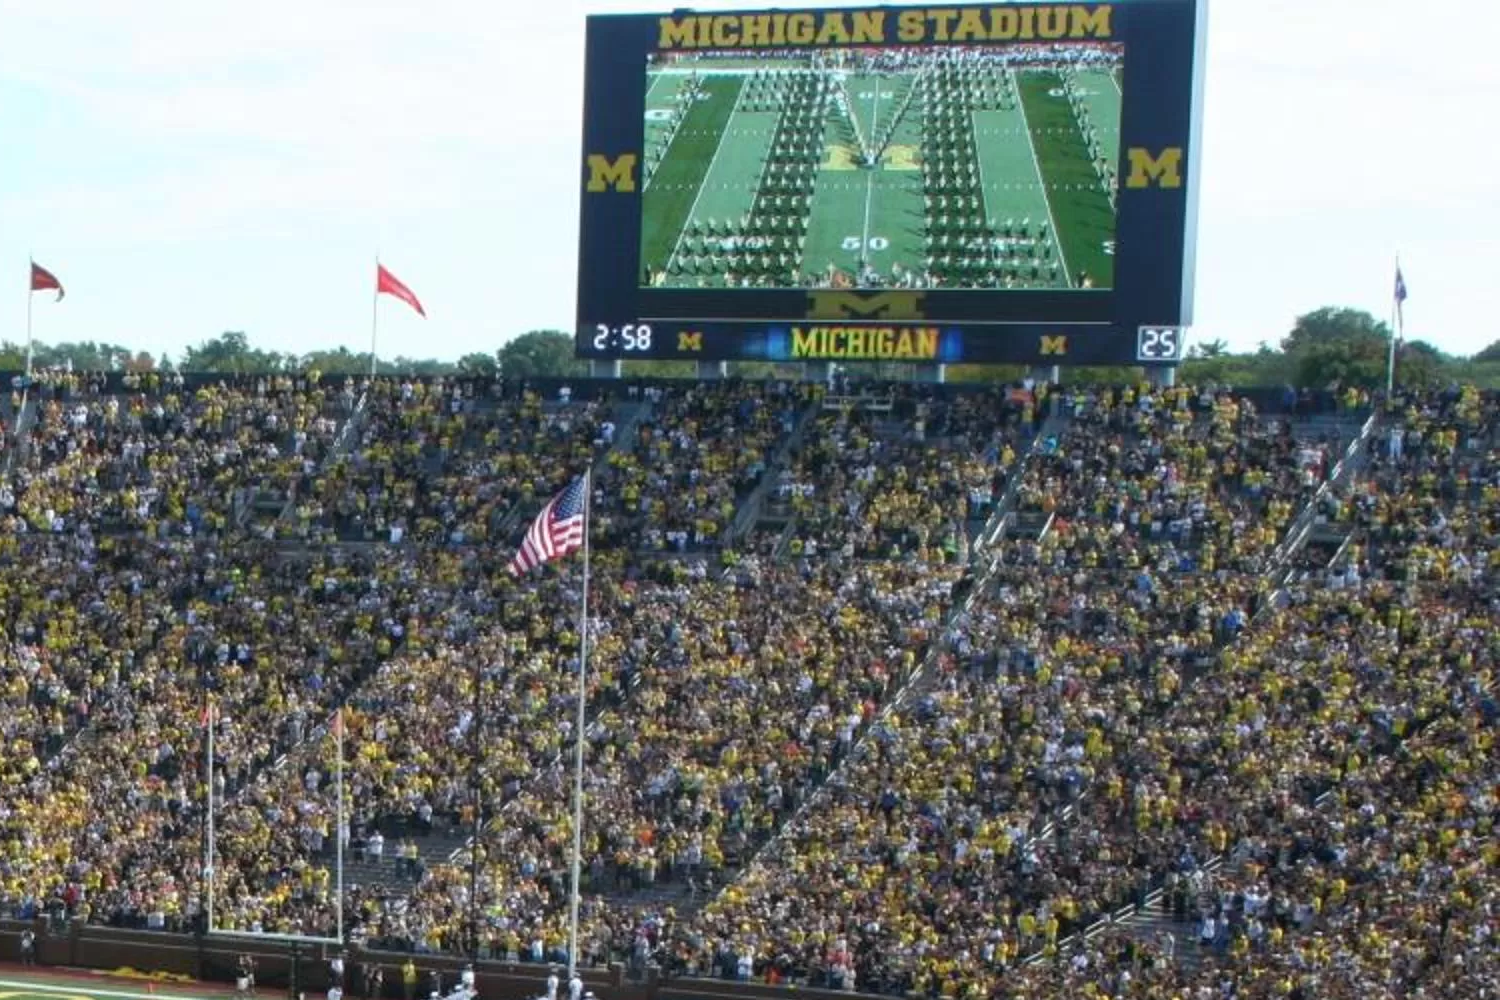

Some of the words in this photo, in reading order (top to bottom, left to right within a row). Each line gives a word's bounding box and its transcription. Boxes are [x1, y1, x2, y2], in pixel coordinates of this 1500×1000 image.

[659, 11, 884, 48] MICHIGAN
[897, 5, 1112, 42] STADIUM
[587, 154, 636, 192] M
[1126, 147, 1181, 188] M
[593, 324, 651, 350] 2:58
[678, 331, 702, 350] M
[791, 326, 939, 359] MICHIGAN
[1040, 335, 1067, 355] M
[1141, 329, 1175, 356] 25
